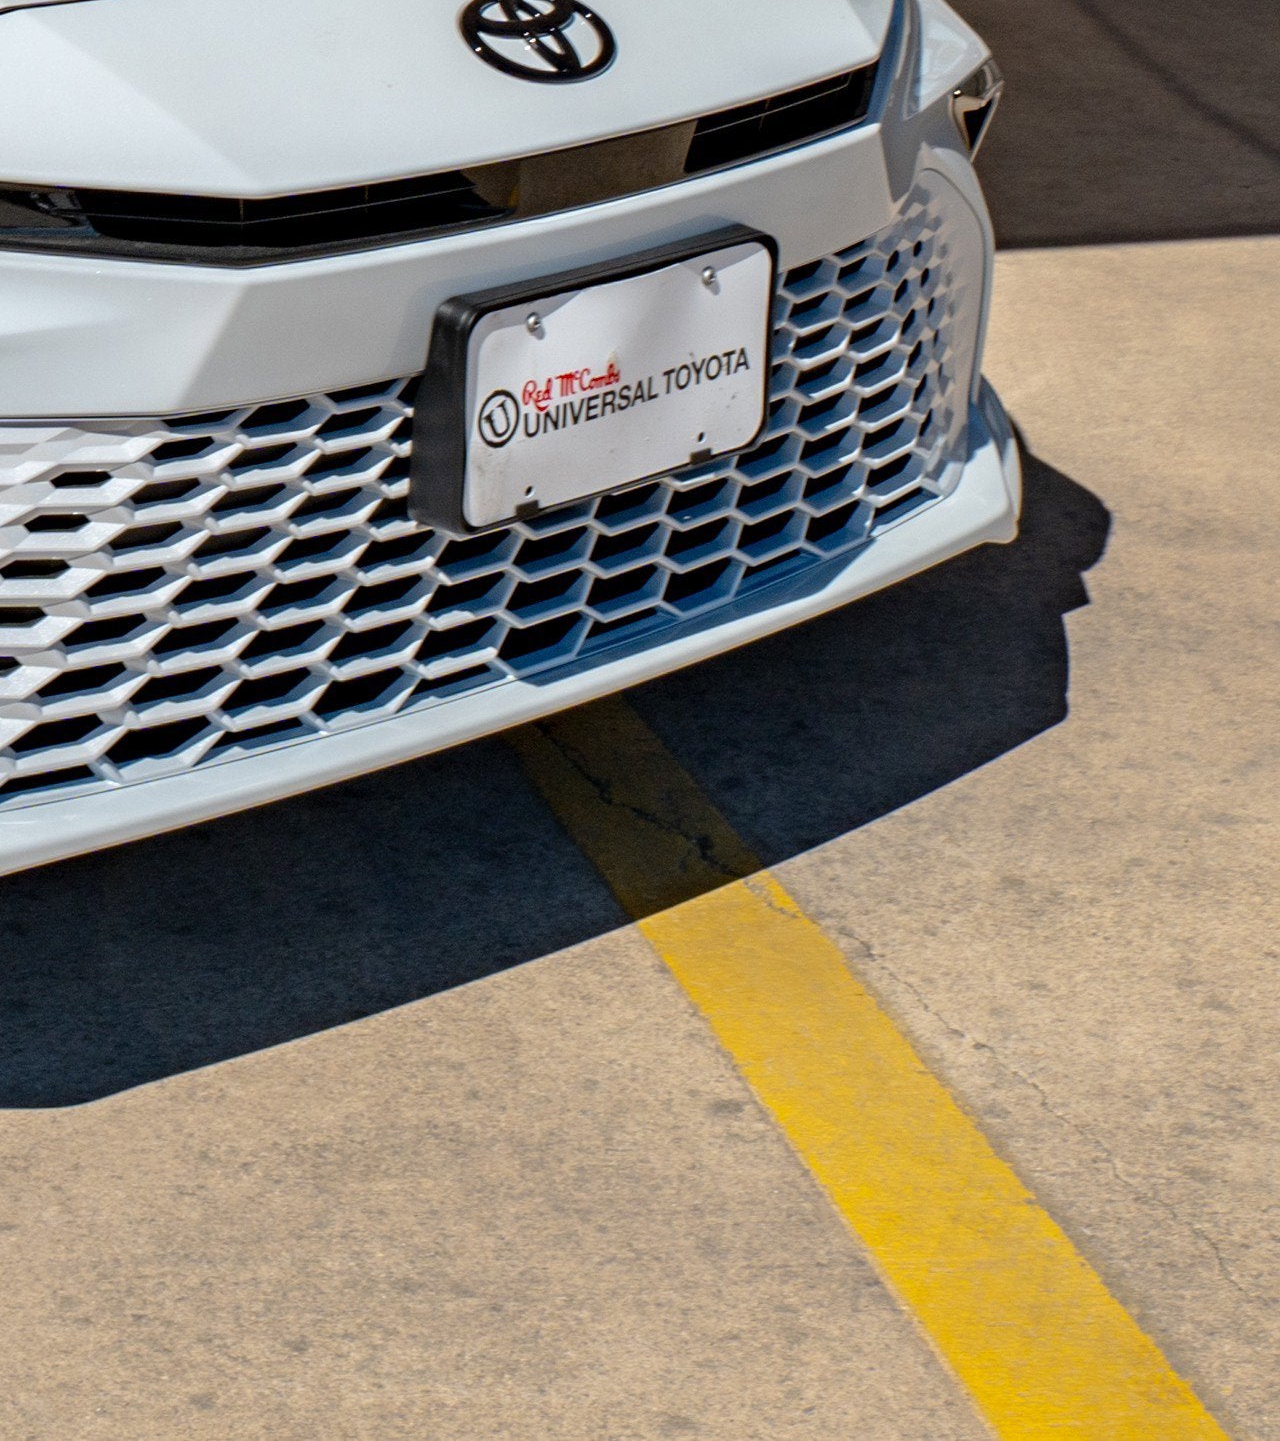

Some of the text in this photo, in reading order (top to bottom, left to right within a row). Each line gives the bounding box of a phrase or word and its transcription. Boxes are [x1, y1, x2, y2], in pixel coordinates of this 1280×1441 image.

[522, 347, 751, 439] UNIVERSAL TOYOTA
[522, 377, 553, 413] Red
